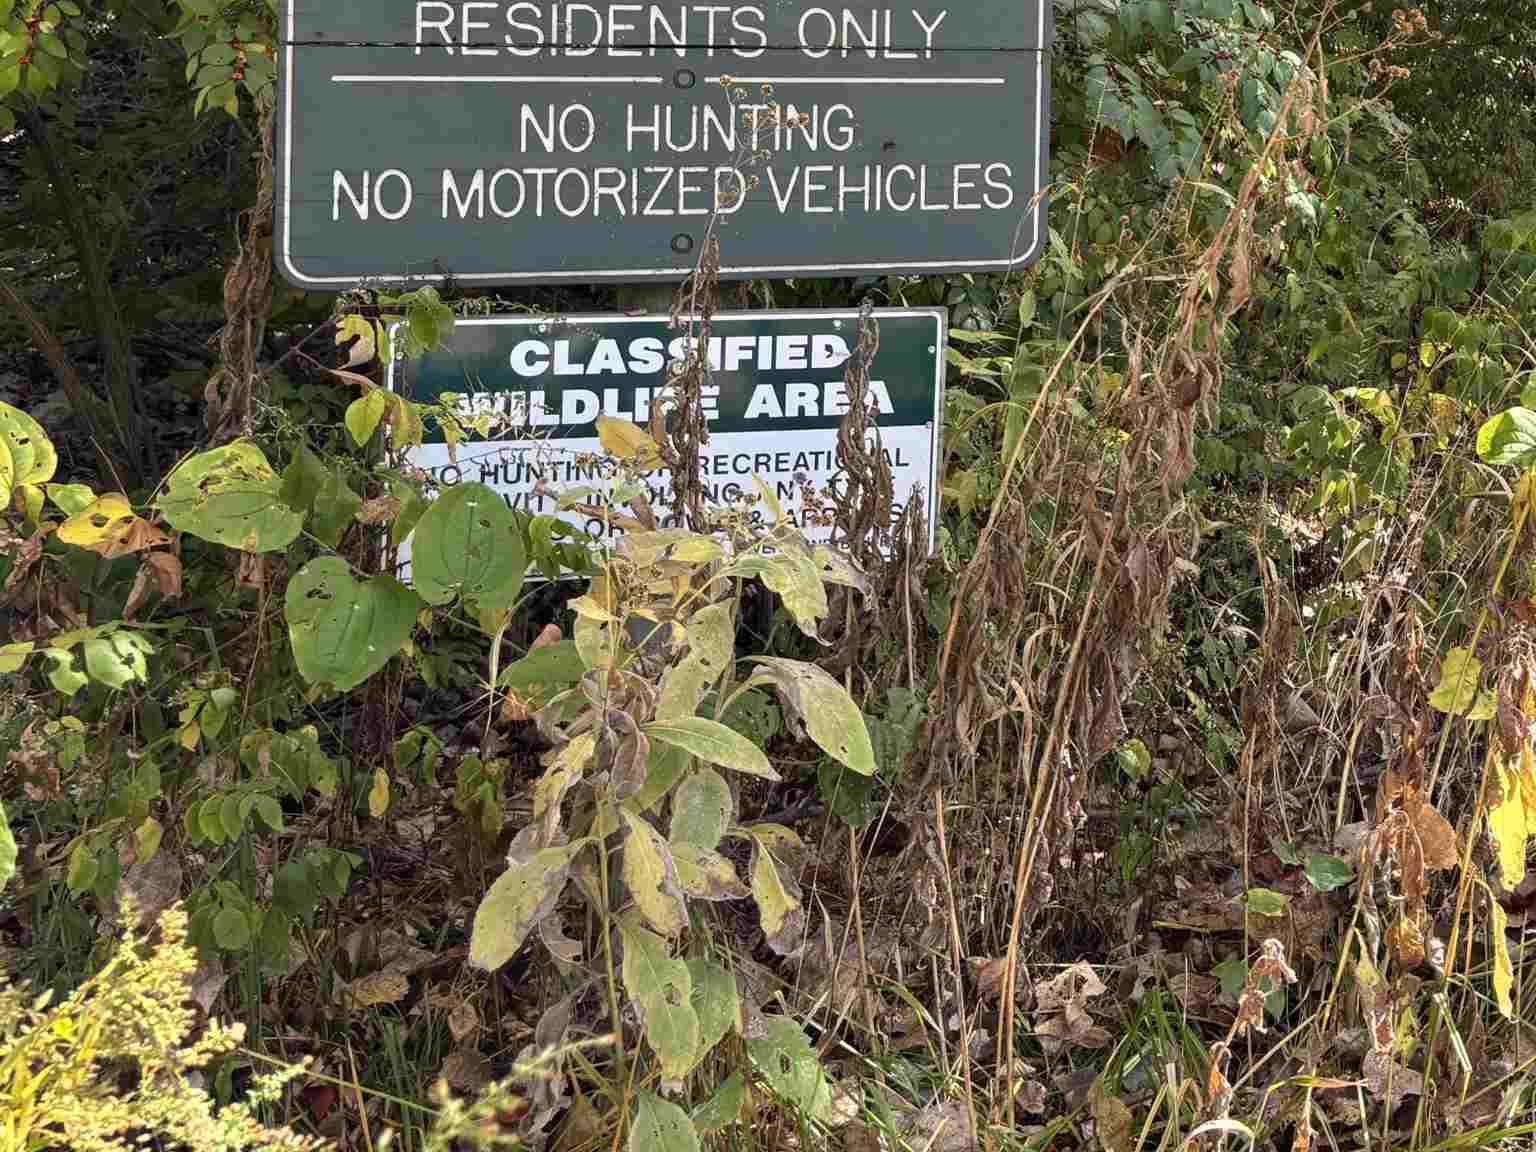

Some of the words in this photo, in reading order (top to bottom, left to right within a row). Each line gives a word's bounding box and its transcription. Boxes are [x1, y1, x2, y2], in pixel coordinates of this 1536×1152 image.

[415, 1, 767, 58] RESIDENTS
[798, 7, 947, 59] ONLY
[520, 103, 595, 152] NO
[627, 103, 855, 151] HUNTING
[332, 168, 412, 221] NO
[441, 166, 747, 219] MOTORIZED
[766, 163, 1014, 214] VEHICLES
[743, 380, 895, 419] AREA
[697, 448, 910, 475] RECREATIAL
